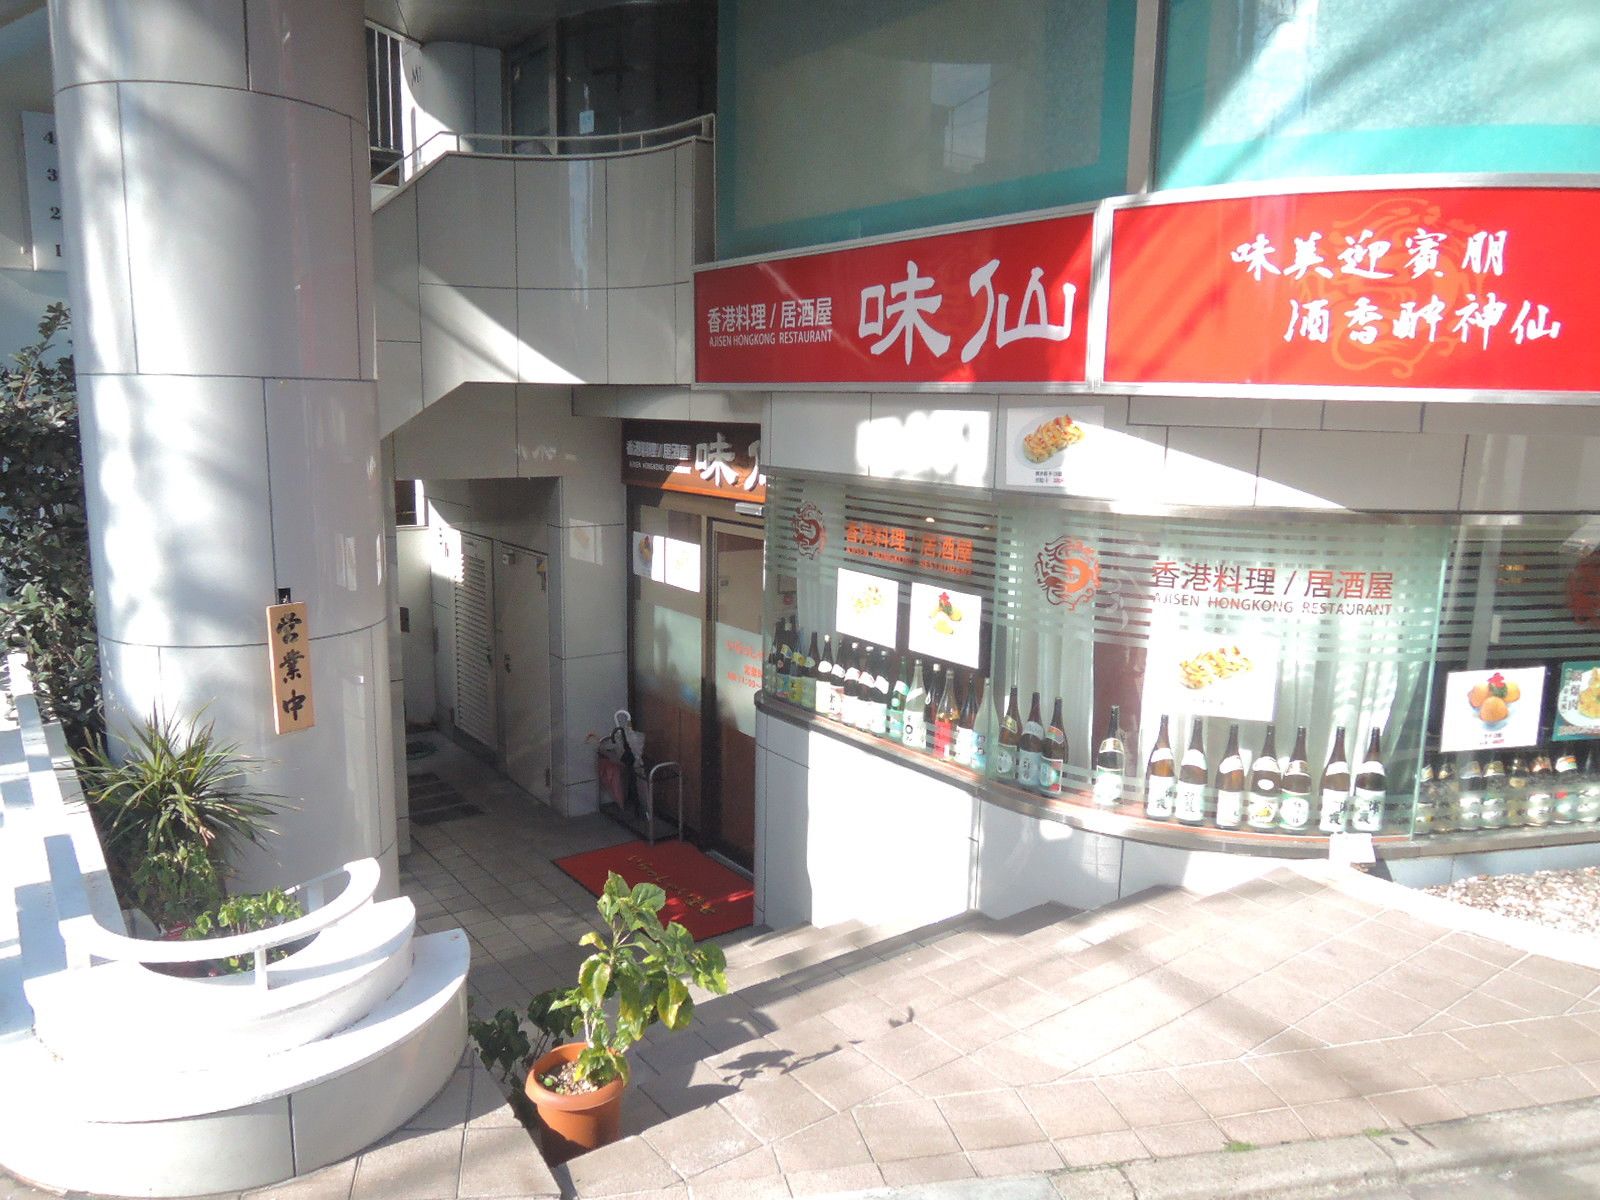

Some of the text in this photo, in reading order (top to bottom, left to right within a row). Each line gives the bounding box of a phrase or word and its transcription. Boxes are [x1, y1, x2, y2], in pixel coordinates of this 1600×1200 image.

[43, 131, 56, 145] 4
[47, 168, 58, 182] 3
[49, 206, 61, 220] 2
[858, 259, 1077, 365] 味仙
[709, 329, 833, 347] AJISEN HONGKONG RESTAURANT
[1152, 592, 1393, 616] AJISEN HONGKONG RESTAURANT
